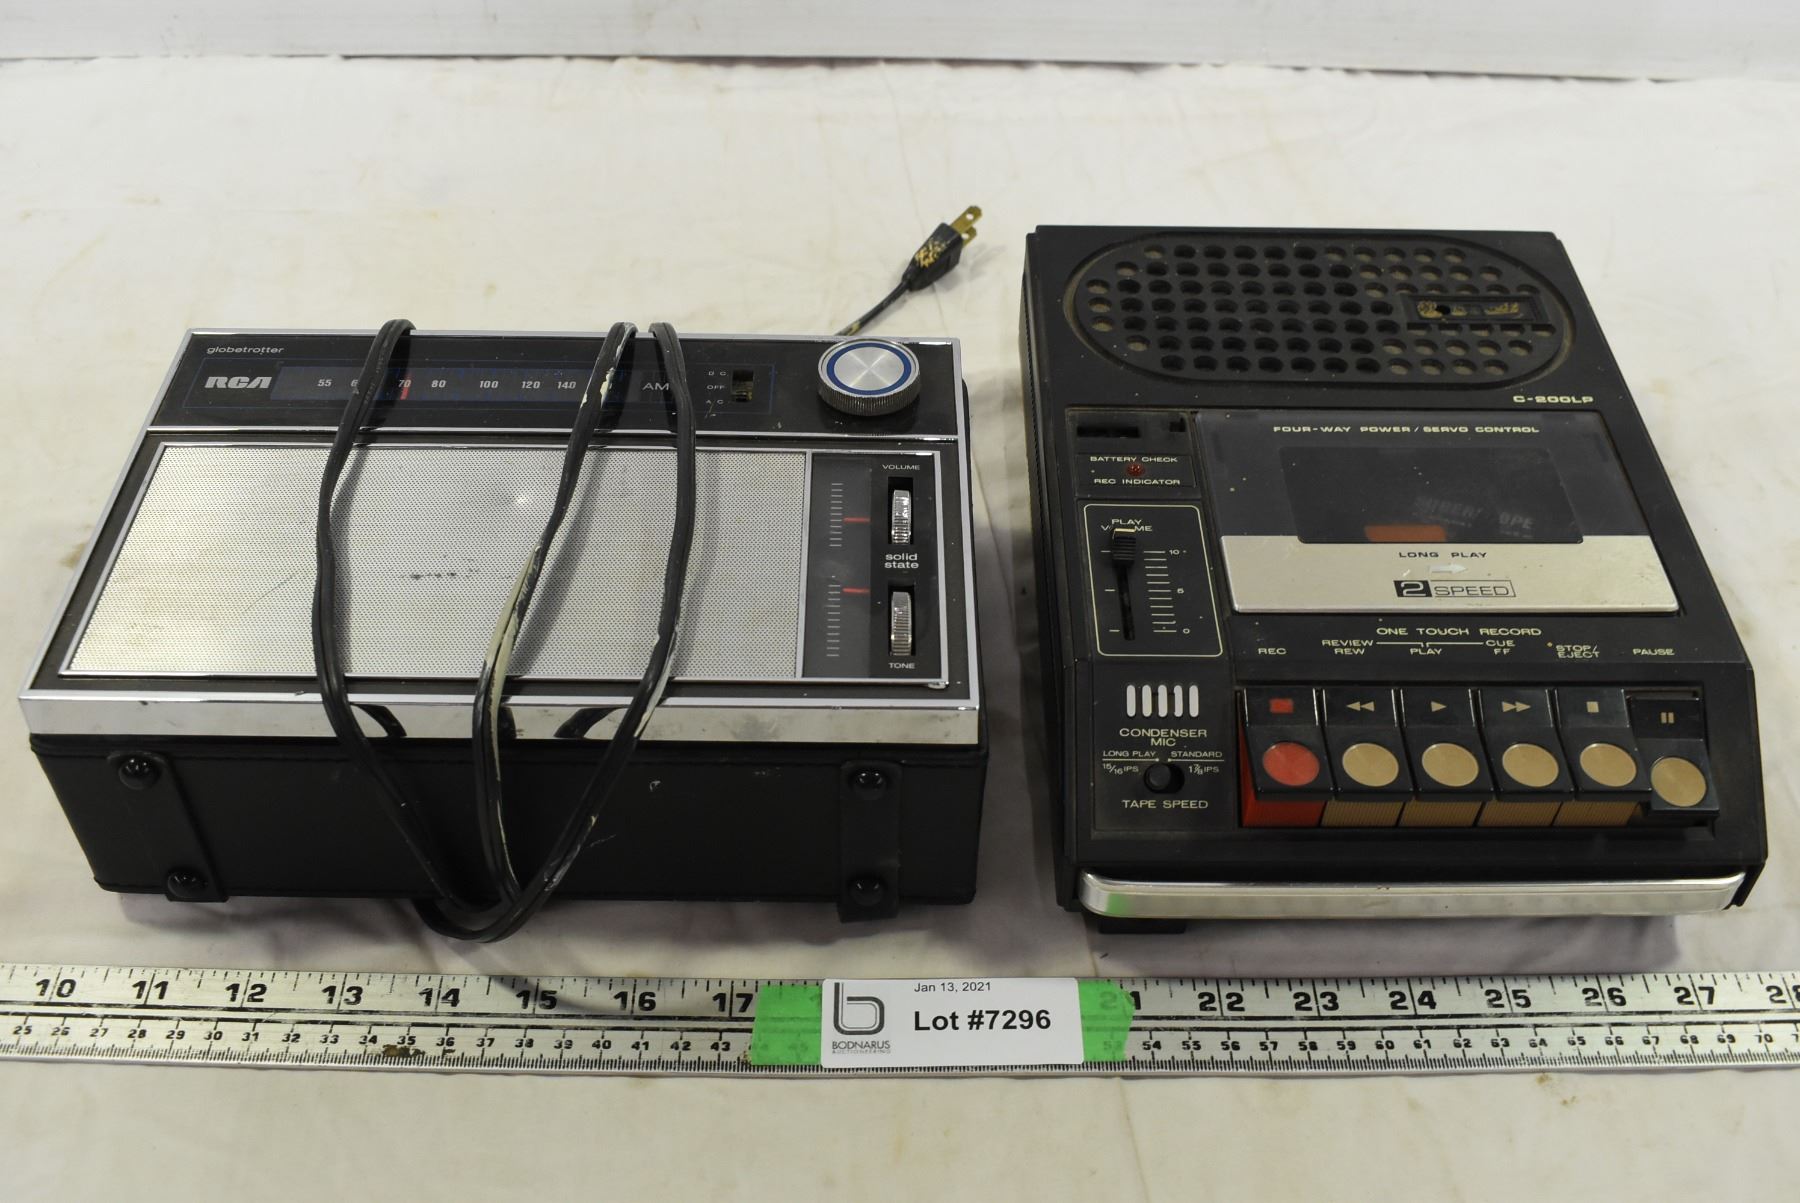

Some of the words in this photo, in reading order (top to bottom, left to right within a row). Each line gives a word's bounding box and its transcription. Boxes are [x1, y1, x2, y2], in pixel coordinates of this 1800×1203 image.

[206, 345, 284, 355] globetrotter
[205, 376, 272, 389] RCA
[317, 379, 332, 387] 55
[398, 379, 412, 388] 70
[431, 379, 447, 388] 80
[479, 379, 499, 389] 100
[521, 380, 541, 389] 120
[557, 380, 577, 389] 140
[642, 382, 670, 391] AM
[1512, 395, 1594, 404] C-200LP
[885, 553, 919, 562] solid
[884, 561, 920, 570] state
[1400, 581, 1427, 597] 2
[1434, 586, 1510, 596] SPEED
[1376, 627, 1409, 636] ONE
[1416, 627, 1470, 636] TOUCH
[1479, 627, 1542, 636] RECORD
[1321, 639, 1374, 647] REVIEW
[1486, 639, 1515, 647] CUE
[1258, 647, 1287, 655] REC
[1334, 647, 1365, 655] REW
[1409, 647, 1442, 656] PLAY
[1556, 644, 1598, 652] STOP/
[1632, 648, 1675, 656] PAUSE
[1557, 651, 1600, 659] EJECT
[888, 662, 916, 670] TONE
[1119, 727, 1208, 738] CONDENSER
[1150, 737, 1176, 747] MIC
[1103, 750, 1129, 758] LONG
[1132, 750, 1156, 758] PLAY
[1122, 799, 1157, 809] TAPE
[1163, 799, 1209, 809] SPEED
[913, 982, 937, 993] Jan
[939, 982, 959, 994] 13,
[962, 981, 992, 992] 2021
[36, 978, 77, 998] 10
[132, 980, 169, 1000] 11
[225, 983, 268, 1003] 12
[321, 985, 364, 1006] 13
[418, 987, 461, 1008] 14
[515, 990, 559, 1010] 15
[613, 991, 657, 1012] 16
[712, 992, 754, 1013] 17
[1198, 991, 1246, 1012] 22
[1294, 991, 1340, 1012] 23
[1388, 990, 1437, 1011] 24
[1484, 989, 1532, 1009] 25
[1581, 987, 1628, 1007] 26
[1673, 986, 1716, 1006] 27
[913, 1010, 959, 1031] Lot
[967, 1009, 1051, 1031] #7296
[12, 1025, 33, 1035] 25
[50, 1026, 71, 1037] 26
[89, 1028, 109, 1038] 27
[127, 1029, 147, 1039] 28
[165, 1030, 186, 1040] 29
[203, 1031, 223, 1041] 30
[242, 1032, 260, 1042] 31
[281, 1033, 301, 1043] 32
[319, 1034, 340, 1045] 33
[358, 1035, 379, 1045] 34
[396, 1036, 417, 1046] 35
[435, 1037, 456, 1047] 36
[475, 1038, 495, 1047] 37
[513, 1038, 535, 1048] 38
[553, 1039, 573, 1049] 39
[591, 1040, 612, 1050] 40
[631, 1040, 650, 1051] 41
[670, 1041, 691, 1051] 42
[709, 1041, 731, 1051] 43
[1142, 1040, 1162, 1050] 54
[1220, 1040, 1241, 1051] 56
[1259, 1041, 1279, 1051] 57
[1298, 1040, 1319, 1051] 58
[1336, 1040, 1356, 1050] 59
[1375, 1039, 1396, 1050] 60
[1412, 1039, 1432, 1050] 61
[1452, 1038, 1473, 1049] 62
[1490, 1037, 1510, 1048] 63
[1567, 1036, 1586, 1047] 65
[1604, 1036, 1625, 1047] 66
[1641, 1035, 1660, 1046] 67
[1679, 1034, 1700, 1045] 68
[1716, 1034, 1736, 1044] 69
[1754, 1033, 1774, 1043] 70
[832, 1040, 891, 1049] BODNARUS
